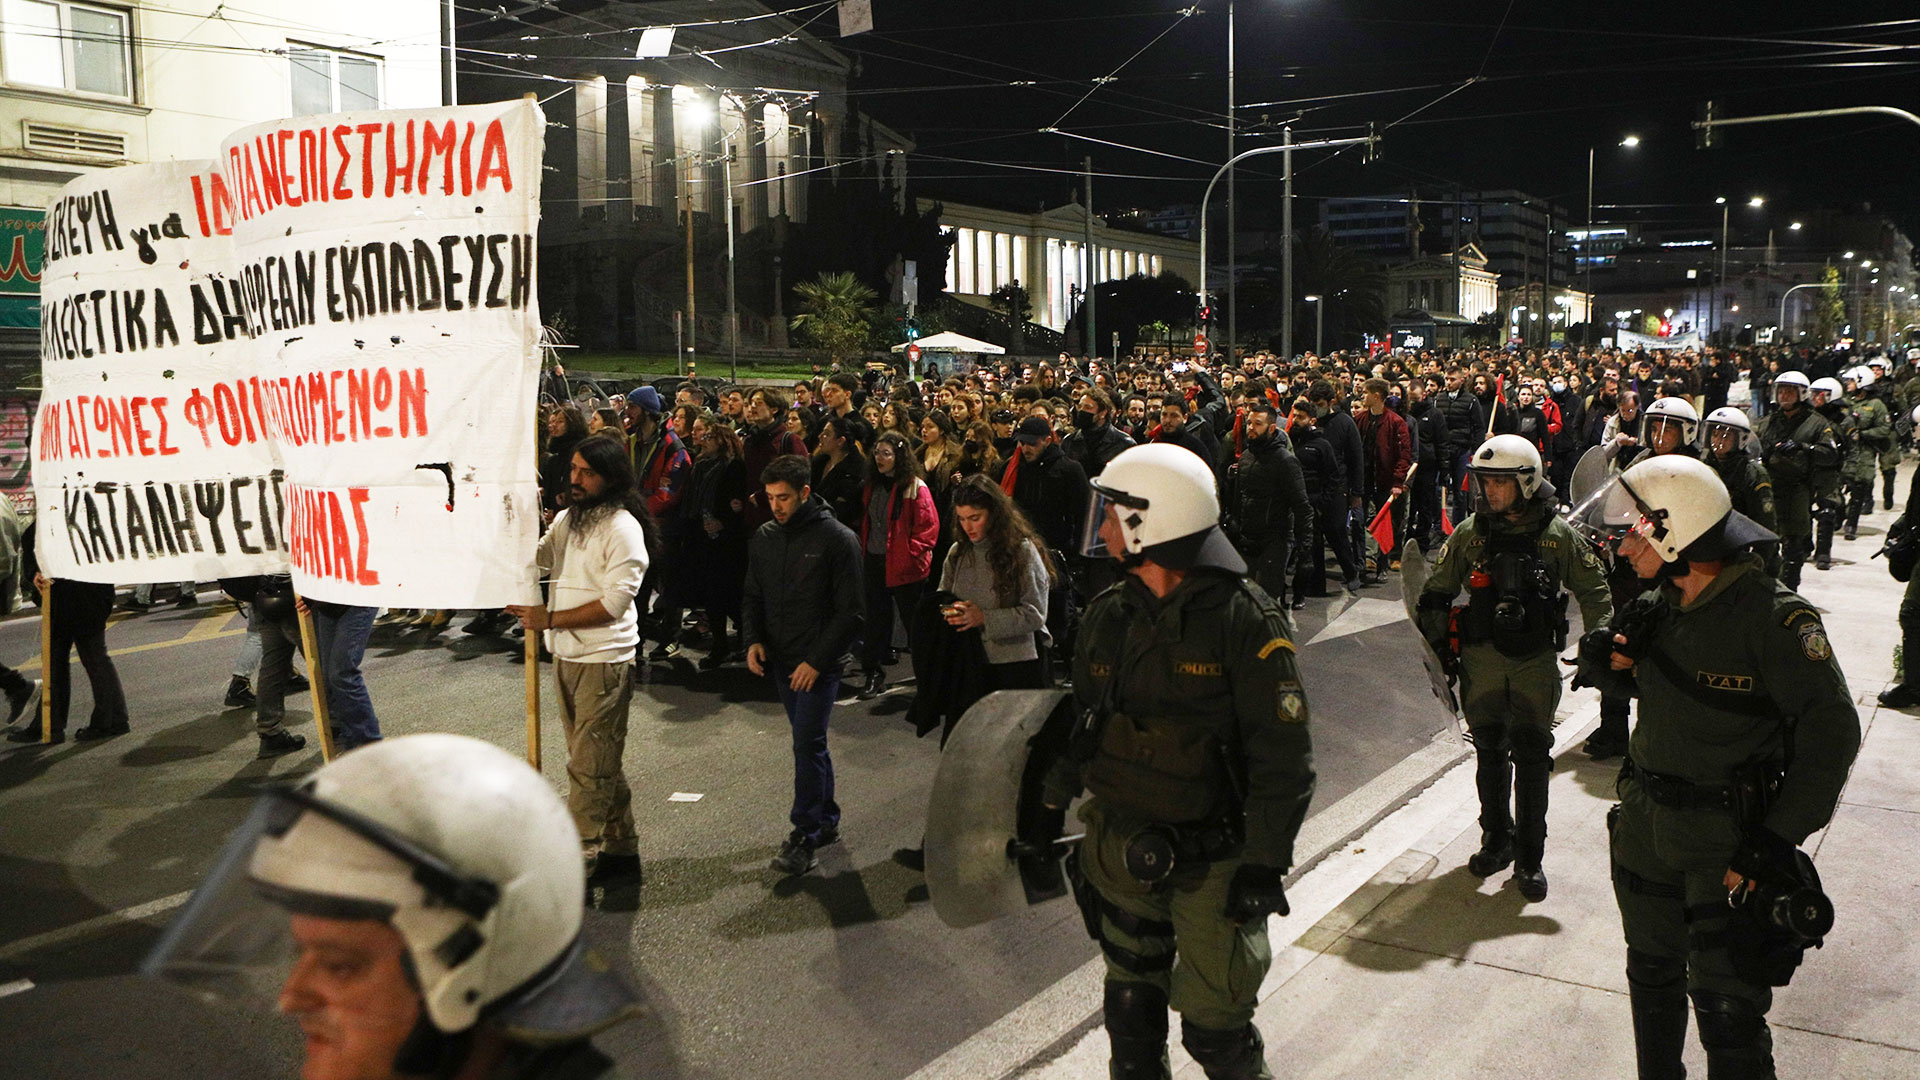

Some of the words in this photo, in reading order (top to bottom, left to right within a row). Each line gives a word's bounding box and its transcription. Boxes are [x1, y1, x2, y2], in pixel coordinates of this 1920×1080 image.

[46, 188, 125, 264] ΣΚΕΨΗ
[190, 171, 234, 238] ΙΔ
[230, 118, 513, 221] ΠΑΝΕΠΙΣΤΗΜΙΑ
[243, 250, 317, 340] ΩΡΕΑΝ
[325, 234, 533, 323] ΕΚΠΑΔΕΥΣΗ
[66, 394, 180, 459] ΑΓΩΝΕΣ
[1178, 662, 1218, 675] POLICE
